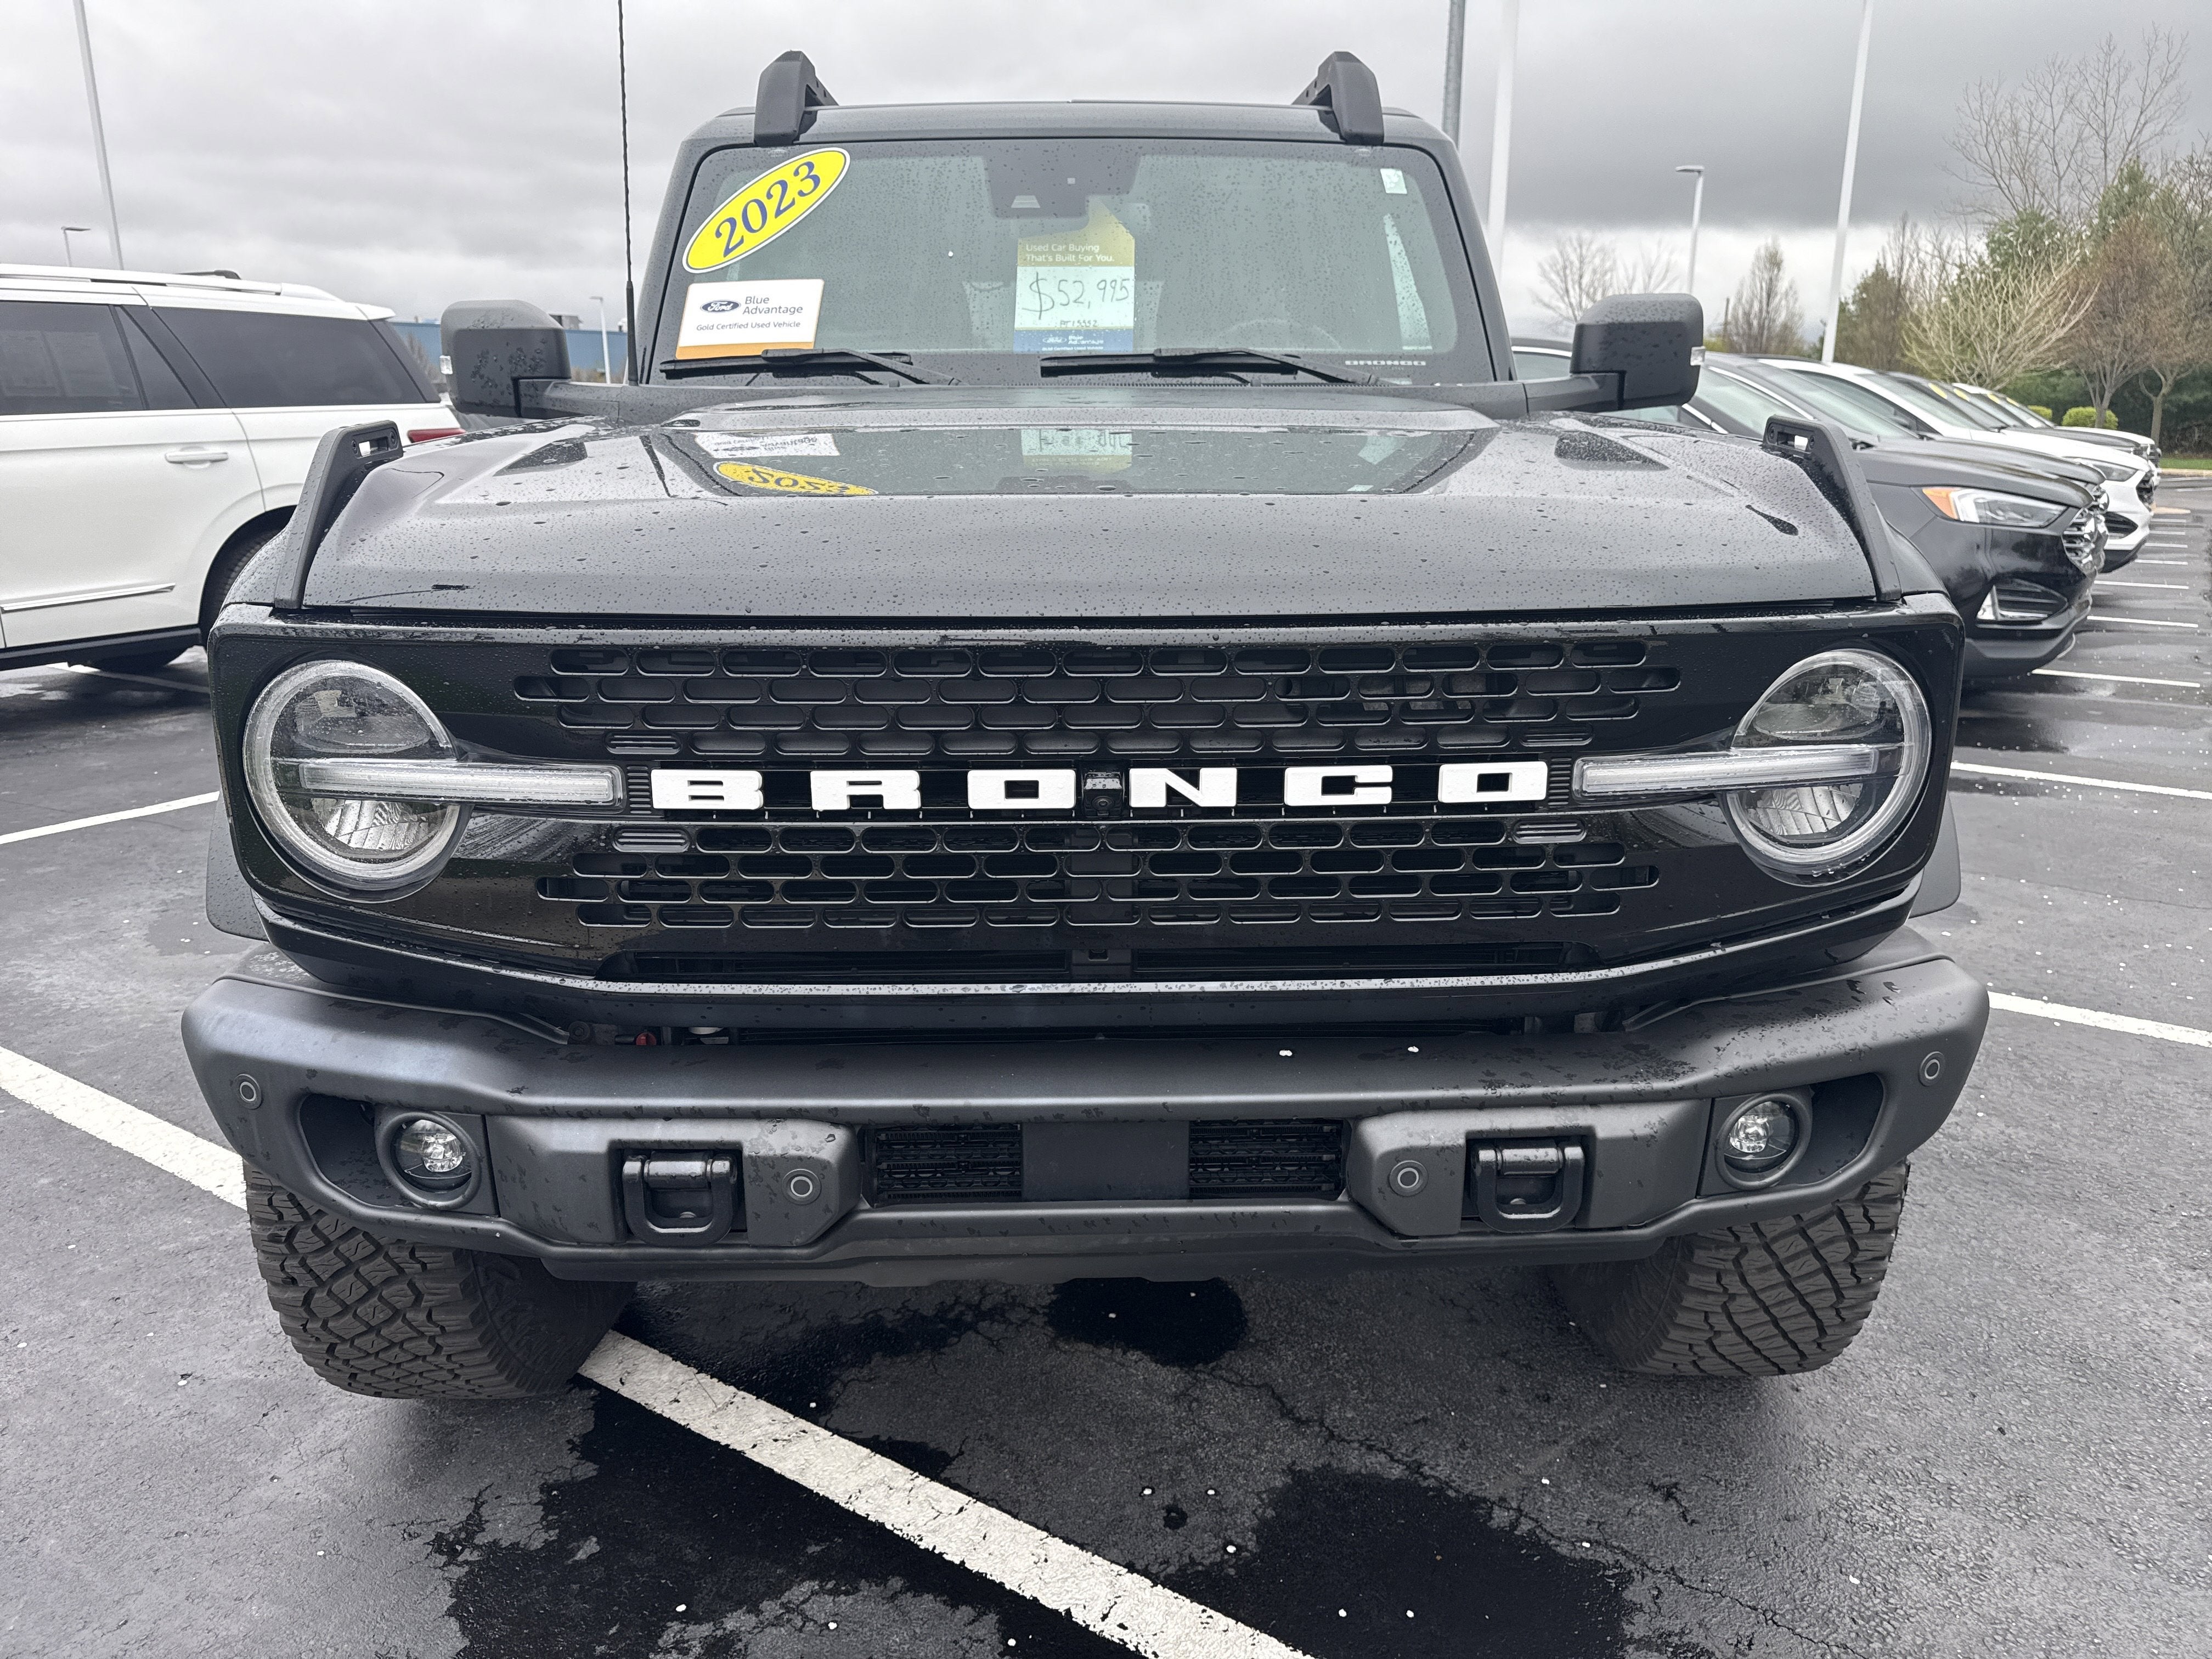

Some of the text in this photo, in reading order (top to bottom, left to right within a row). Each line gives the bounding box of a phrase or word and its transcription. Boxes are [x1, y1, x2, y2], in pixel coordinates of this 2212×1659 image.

[714, 161, 821, 258] 2023
[1026, 243, 1100, 253] Used Car Buying
[744, 296, 770, 304] Blue
[1022, 272, 1131, 320] $52,995
[742, 306, 803, 315] Advantage
[716, 322, 749, 330] Certified
[651, 760, 1548, 811] BRONCO
